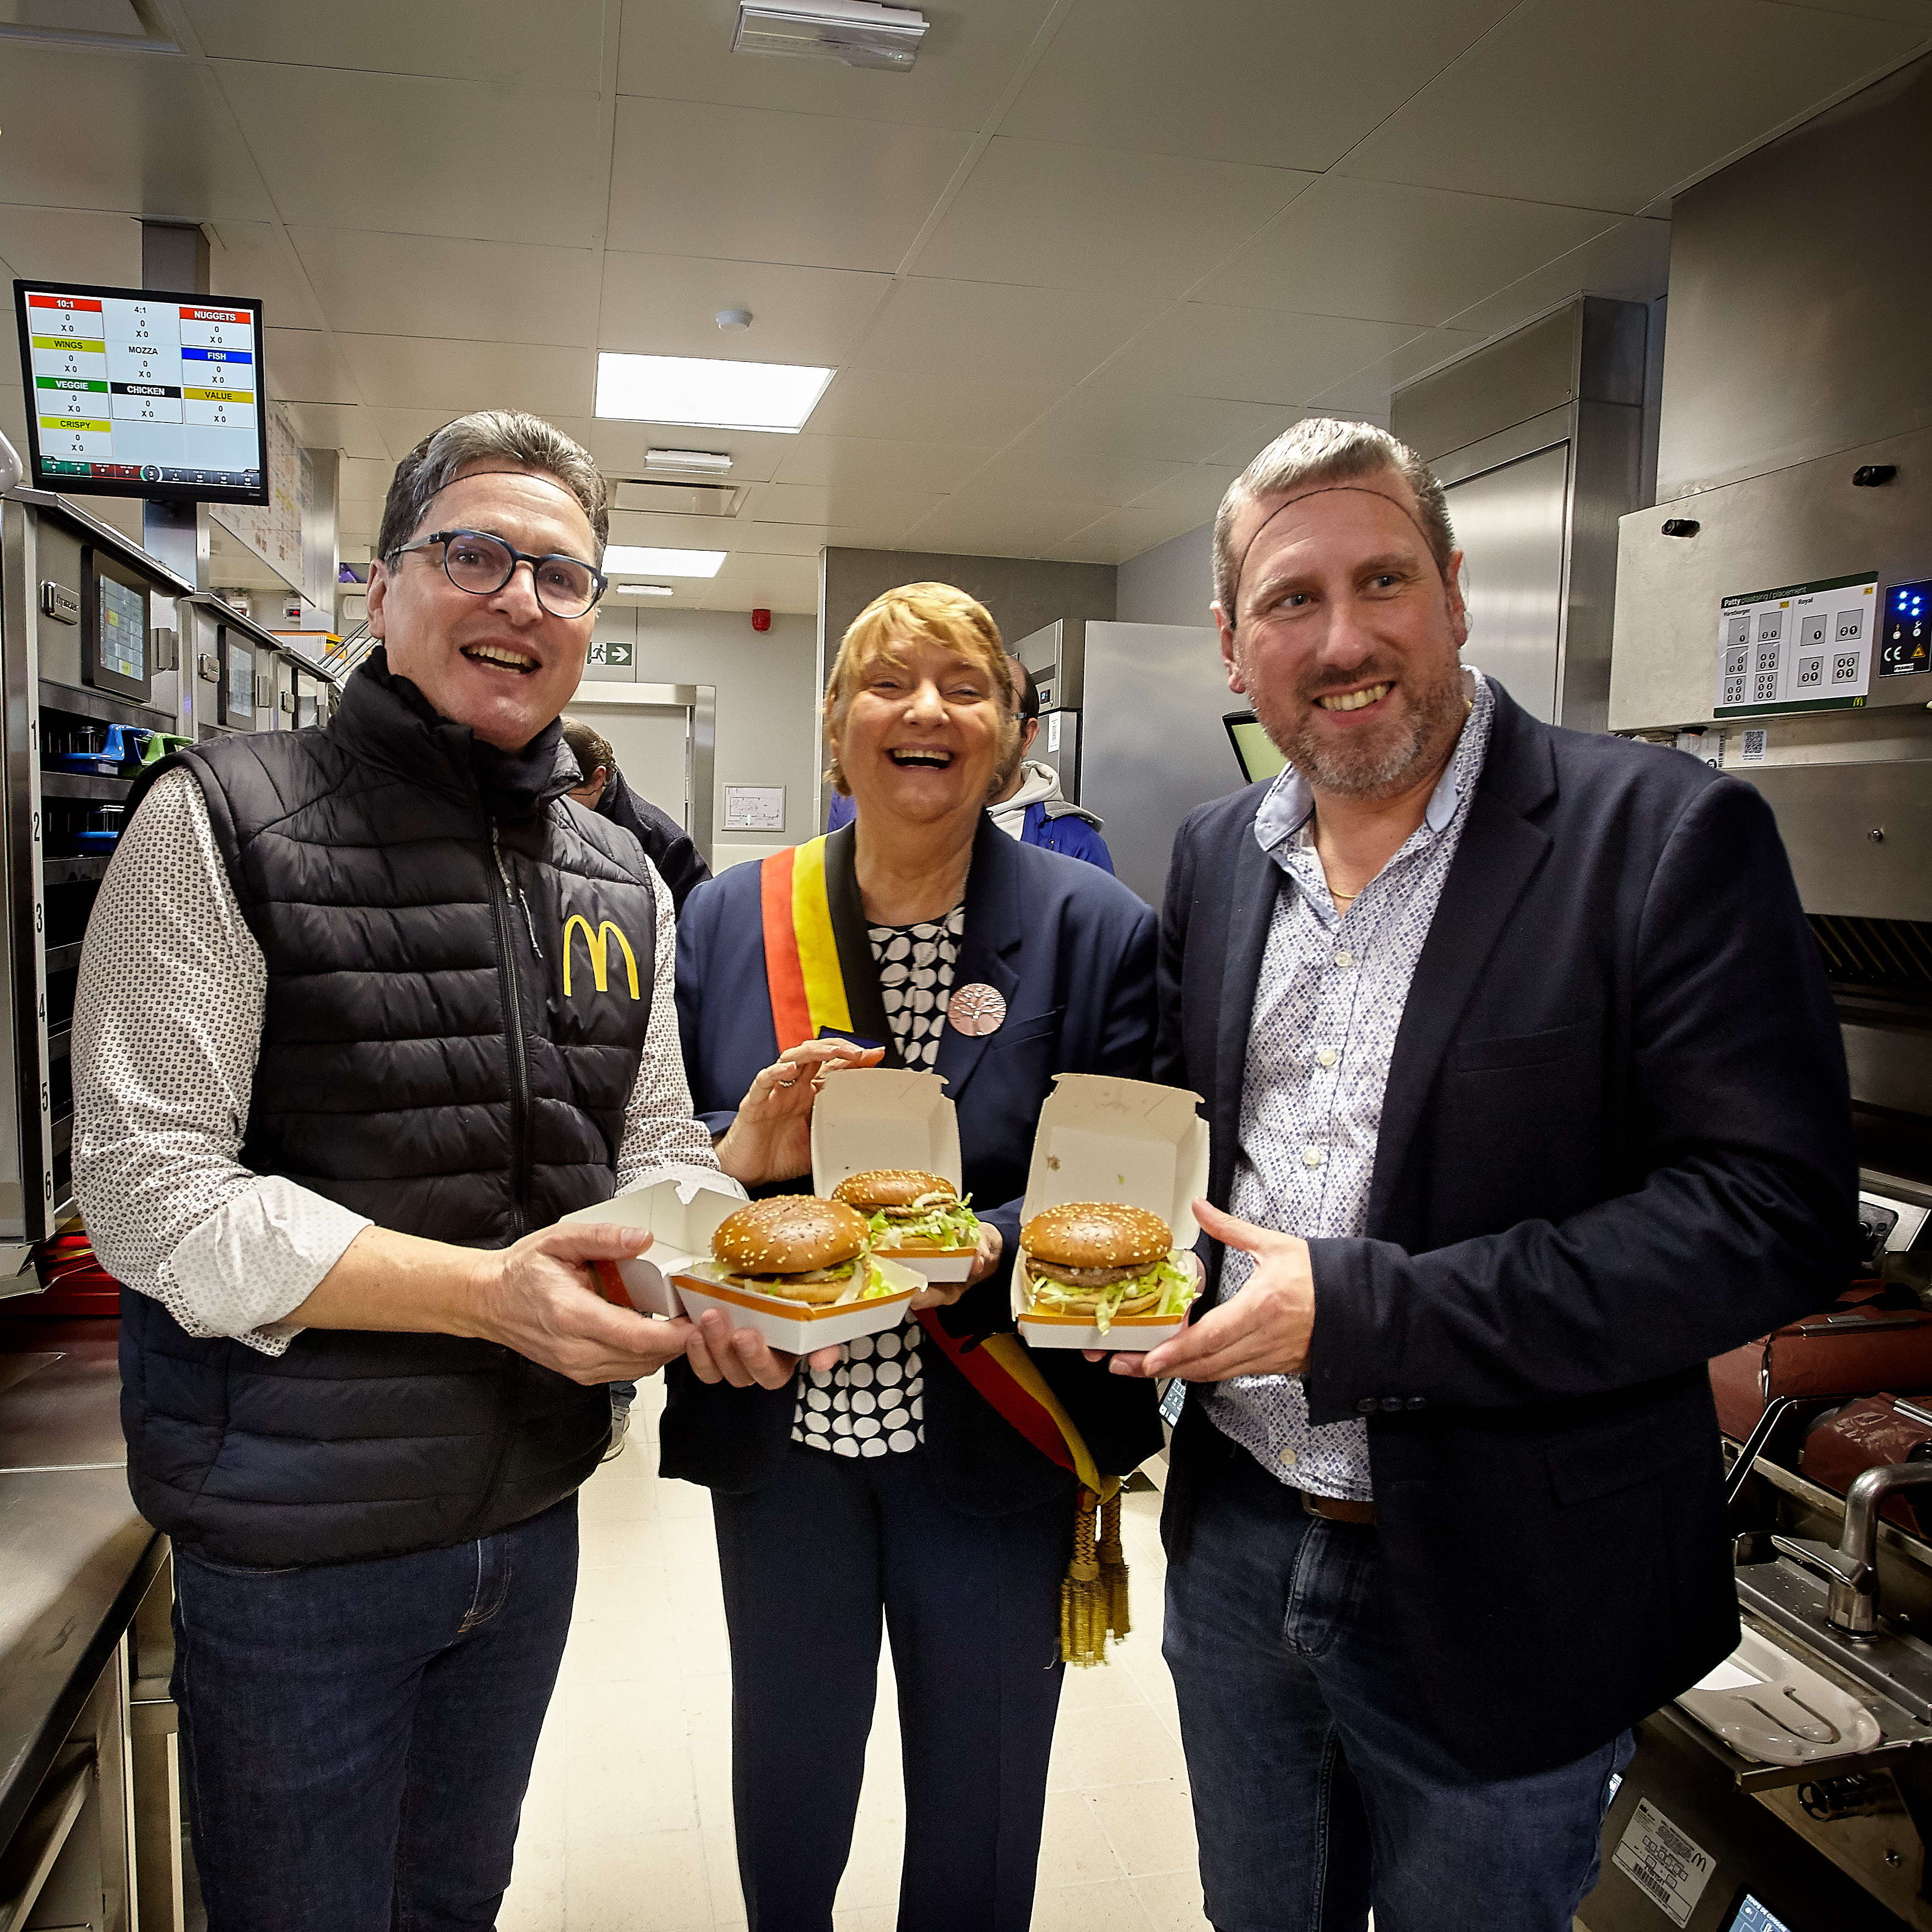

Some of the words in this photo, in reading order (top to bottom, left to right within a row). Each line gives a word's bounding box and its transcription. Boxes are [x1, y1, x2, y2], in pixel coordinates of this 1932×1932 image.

[56, 299, 74, 309] 10:1
[134, 306, 147, 314] 4:1
[194, 310, 236, 322] NUGGETS
[54, 340, 83, 349] WINGS
[129, 346, 158, 355] MOZZA
[207, 351, 227, 361] FISH
[55, 380, 89, 390] VEGGIE
[126, 385, 165, 396] CHICKEN
[204, 390, 233, 401] VALUE
[1724, 598, 1741, 606] Patty
[1772, 587, 1807, 599] placement
[1798, 597, 1814, 605] Royal
[31, 723, 37, 750] 1
[34, 811, 40, 842] 2
[36, 905, 42, 932] 3
[39, 992, 45, 1023] 4
[41, 1083, 48, 1112] 5
[44, 1170, 52, 1201] 6
